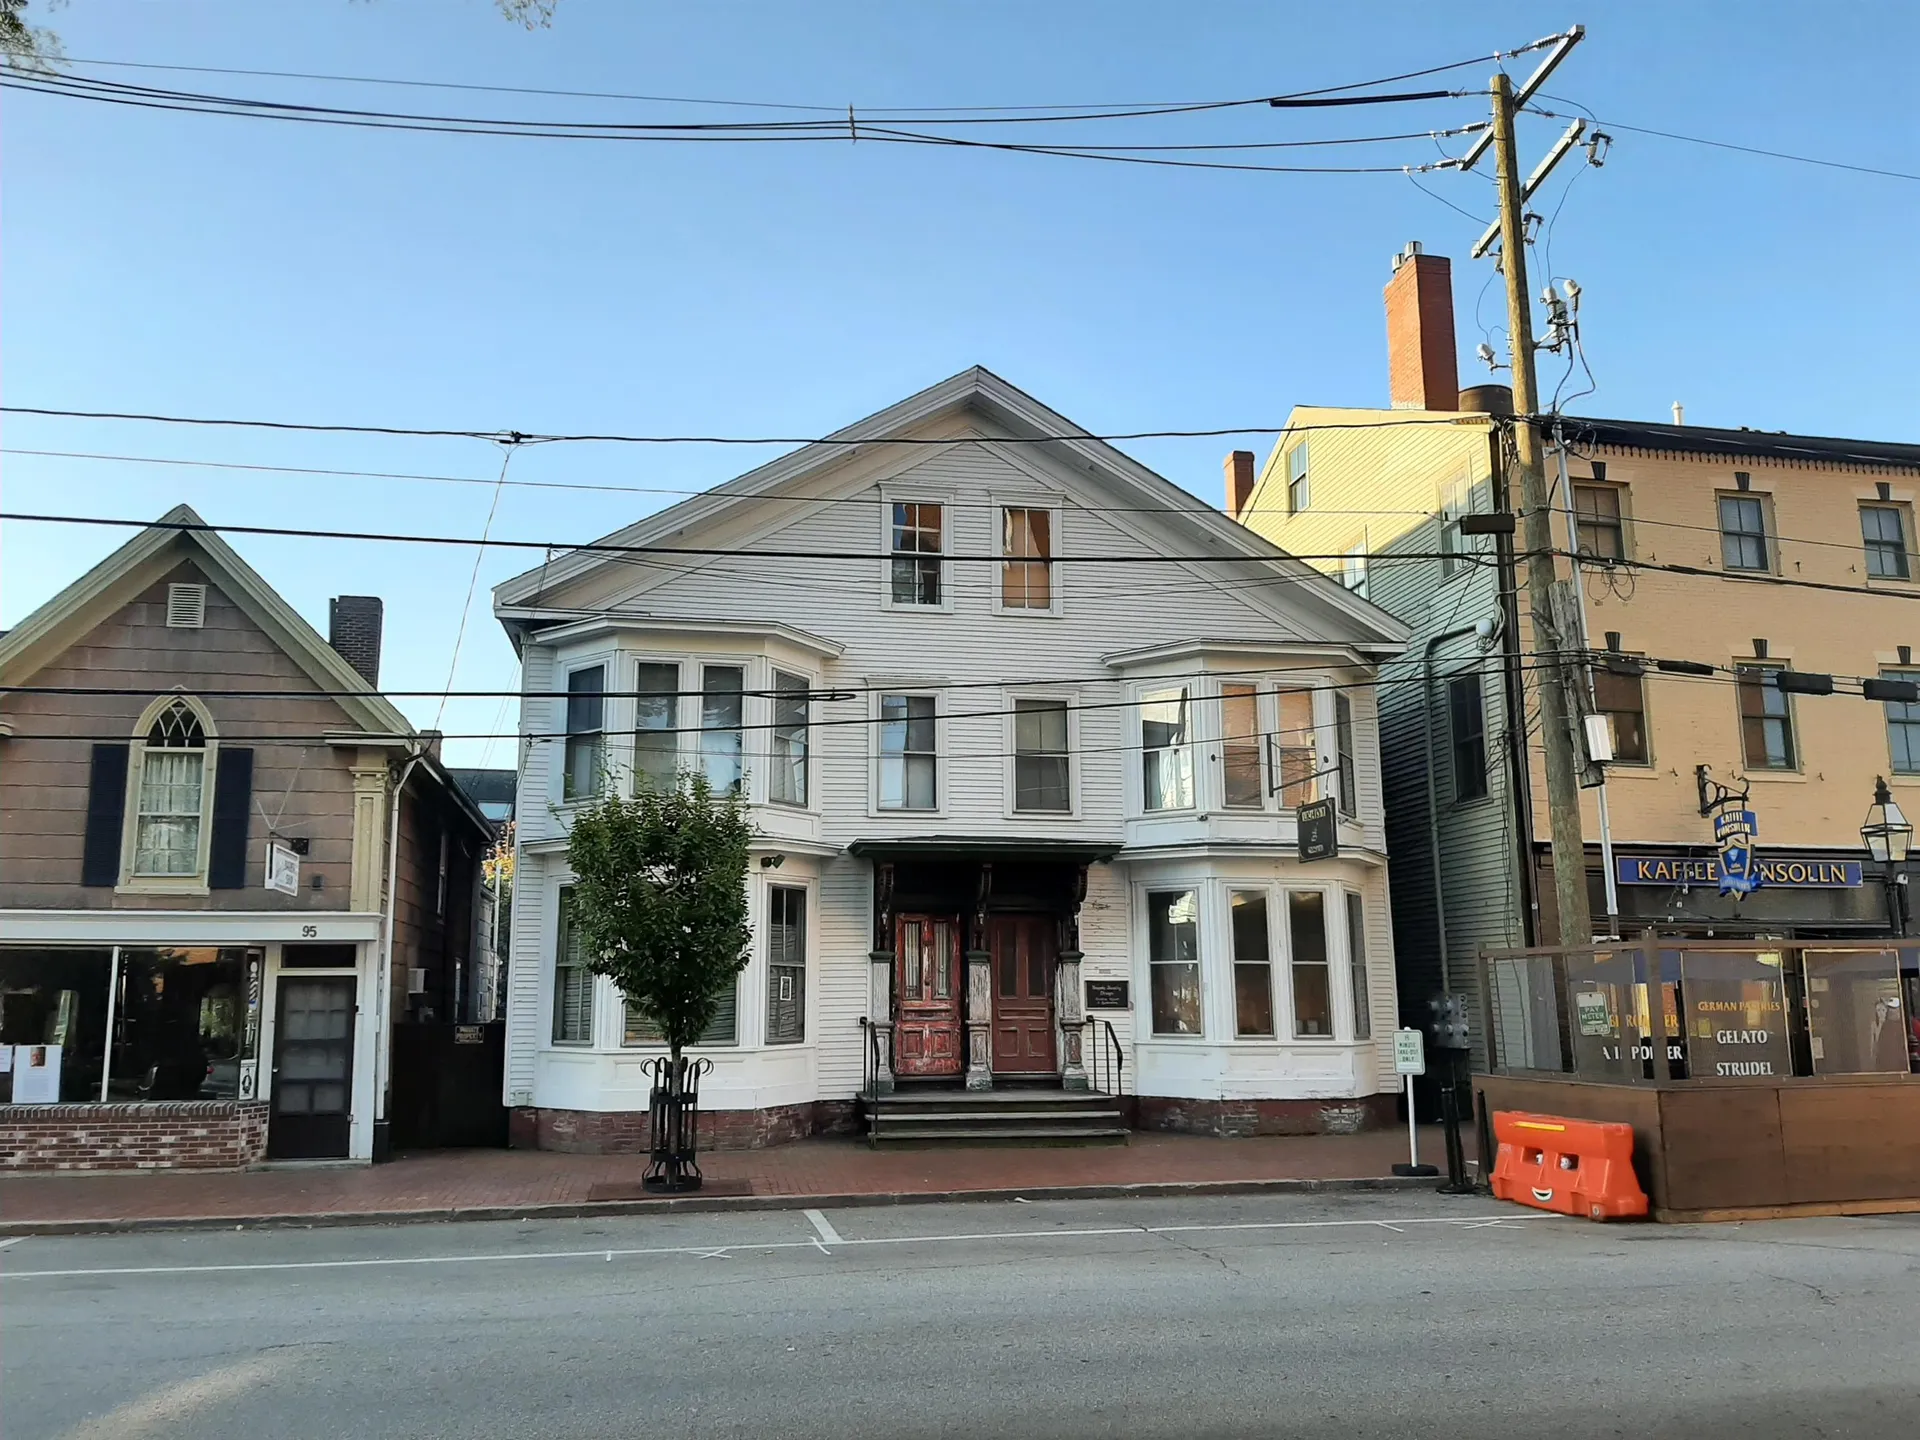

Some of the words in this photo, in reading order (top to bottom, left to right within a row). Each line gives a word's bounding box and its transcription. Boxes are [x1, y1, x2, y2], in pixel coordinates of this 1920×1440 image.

[1637, 860, 1719, 881] KAFFEE
[1757, 862, 1846, 883] NSOLLN
[302, 925, 317, 938] 95
[1698, 1001, 1737, 1012] GERMAN
[1716, 1030, 1768, 1044] GELATO
[1716, 1061, 1774, 1076] STRUDEL
